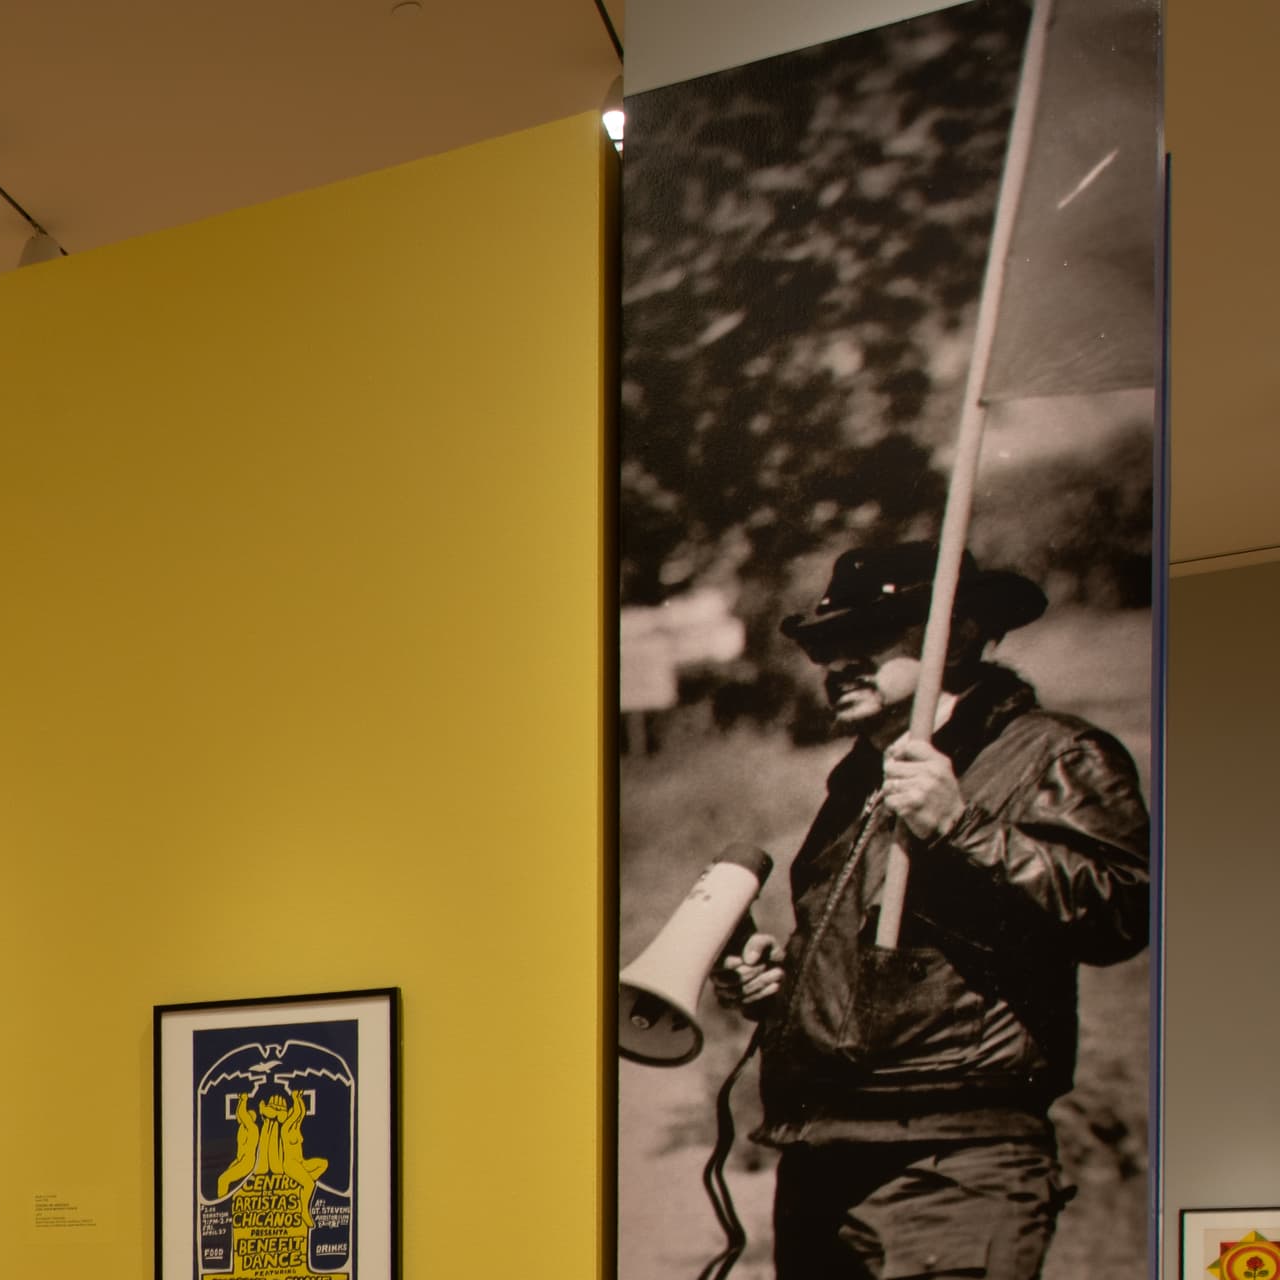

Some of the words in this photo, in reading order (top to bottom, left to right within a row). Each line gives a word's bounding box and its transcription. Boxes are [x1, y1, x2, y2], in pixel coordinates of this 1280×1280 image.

[242, 1174, 300, 1191] CENTRO
[235, 1194, 299, 1211] ARTISTAS
[232, 1211, 302, 1228] CHICANOS
[250, 1229, 288, 1237] PRESENTA
[204, 1248, 224, 1257] FOOD
[237, 1237, 305, 1256] BENEFIT
[316, 1243, 347, 1254] DRINKS
[242, 1252, 301, 1271] DANCE
[255, 1269, 296, 1277] FEATURING
